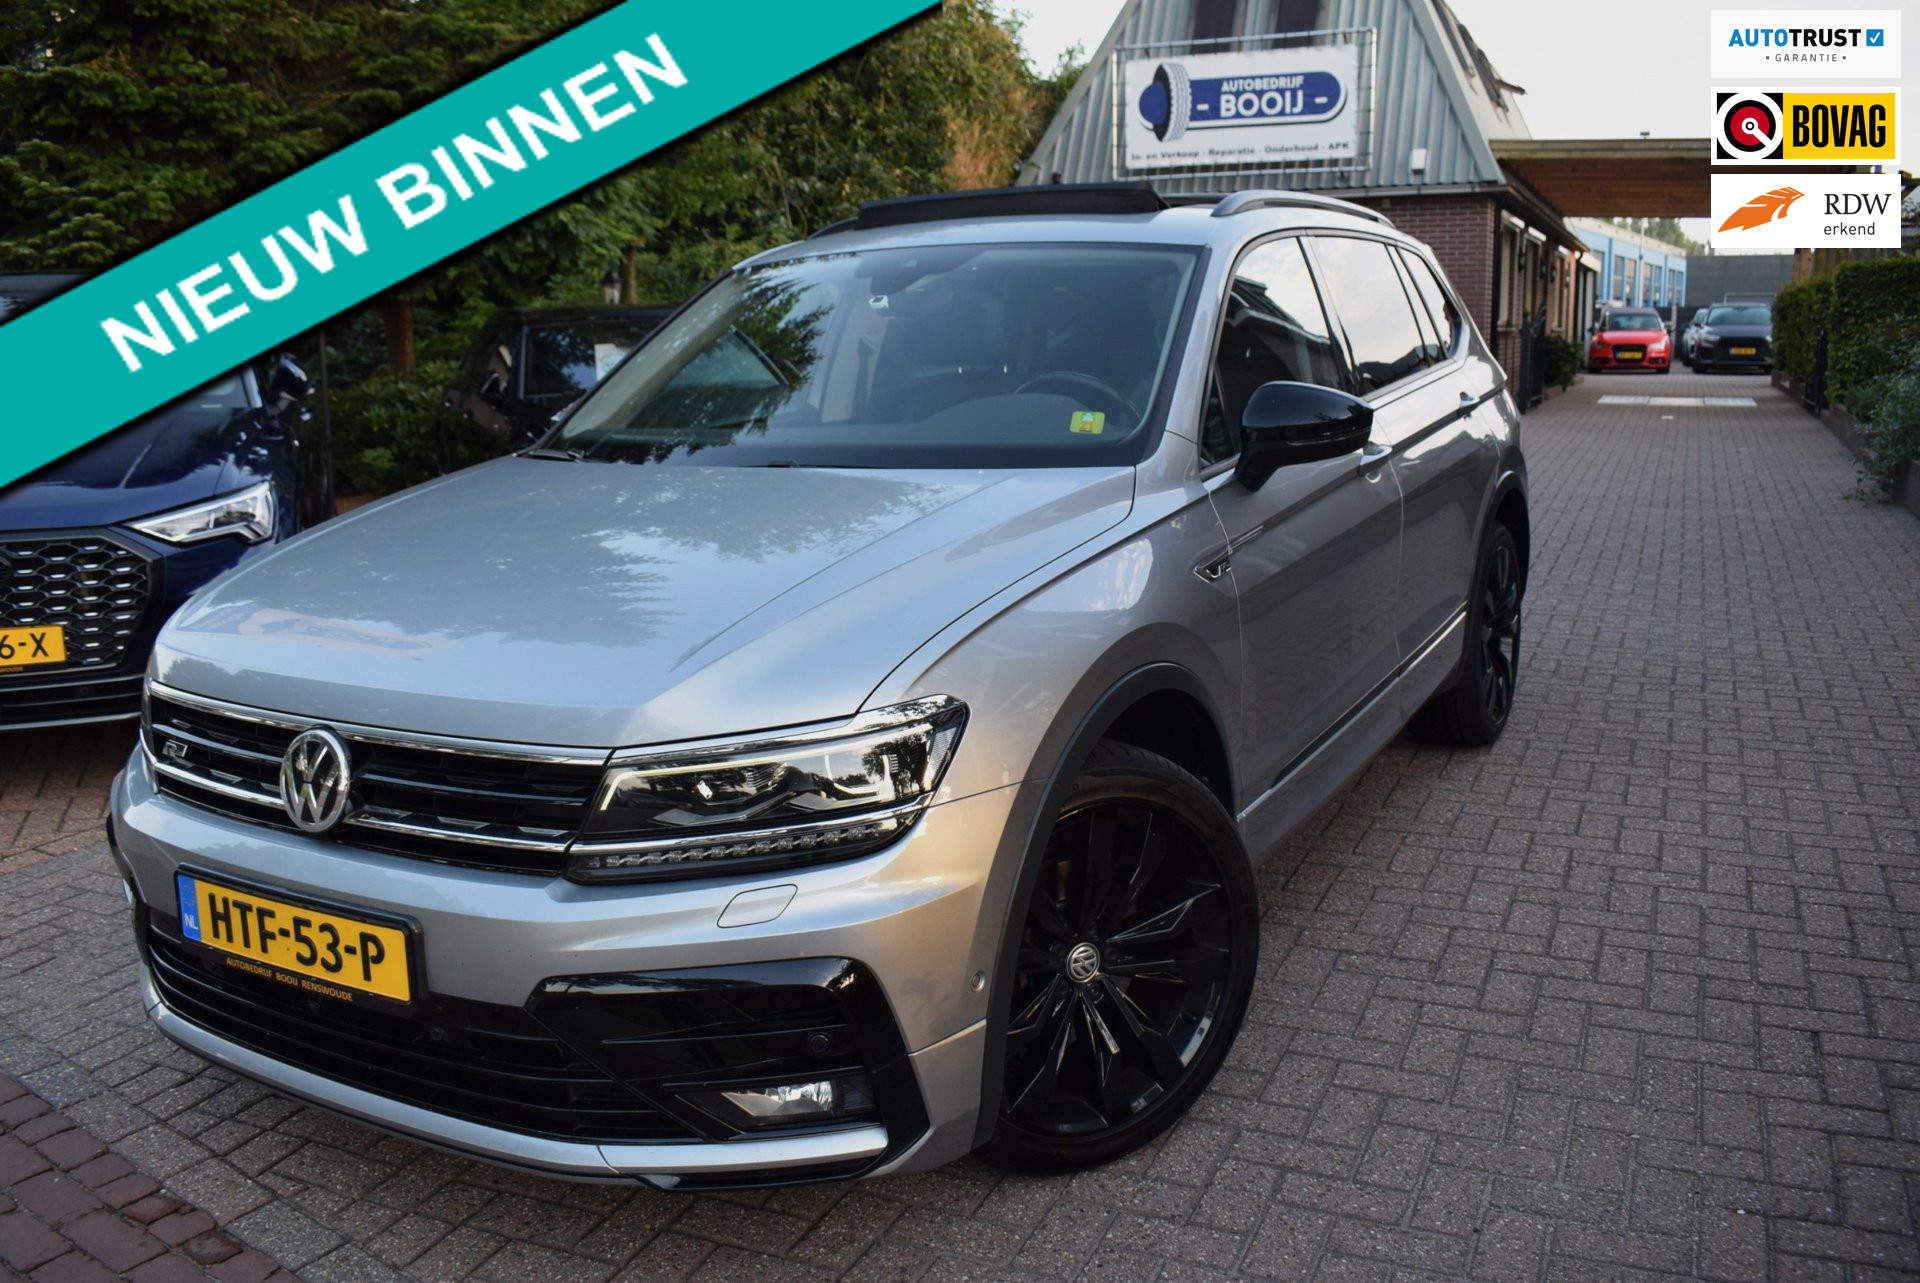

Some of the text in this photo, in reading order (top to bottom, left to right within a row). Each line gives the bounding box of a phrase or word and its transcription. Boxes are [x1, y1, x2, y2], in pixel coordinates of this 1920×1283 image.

[1221, 75, 1304, 92] AUTOBEDRIJF
[1220, 90, 1304, 118] BOOIJ
[1161, 150, 1200, 160] Verkoop
[1208, 147, 1255, 157] Reparatie
[1264, 143, 1319, 154] Onderhoud
[1328, 141, 1349, 150] APK
[184, 912, 199, 931] NL
[208, 892, 385, 982] HTF-53-P
[226, 957, 273, 978] AUTOBEDRIJF
[301, 979, 353, 1002] RENSWOUDE
